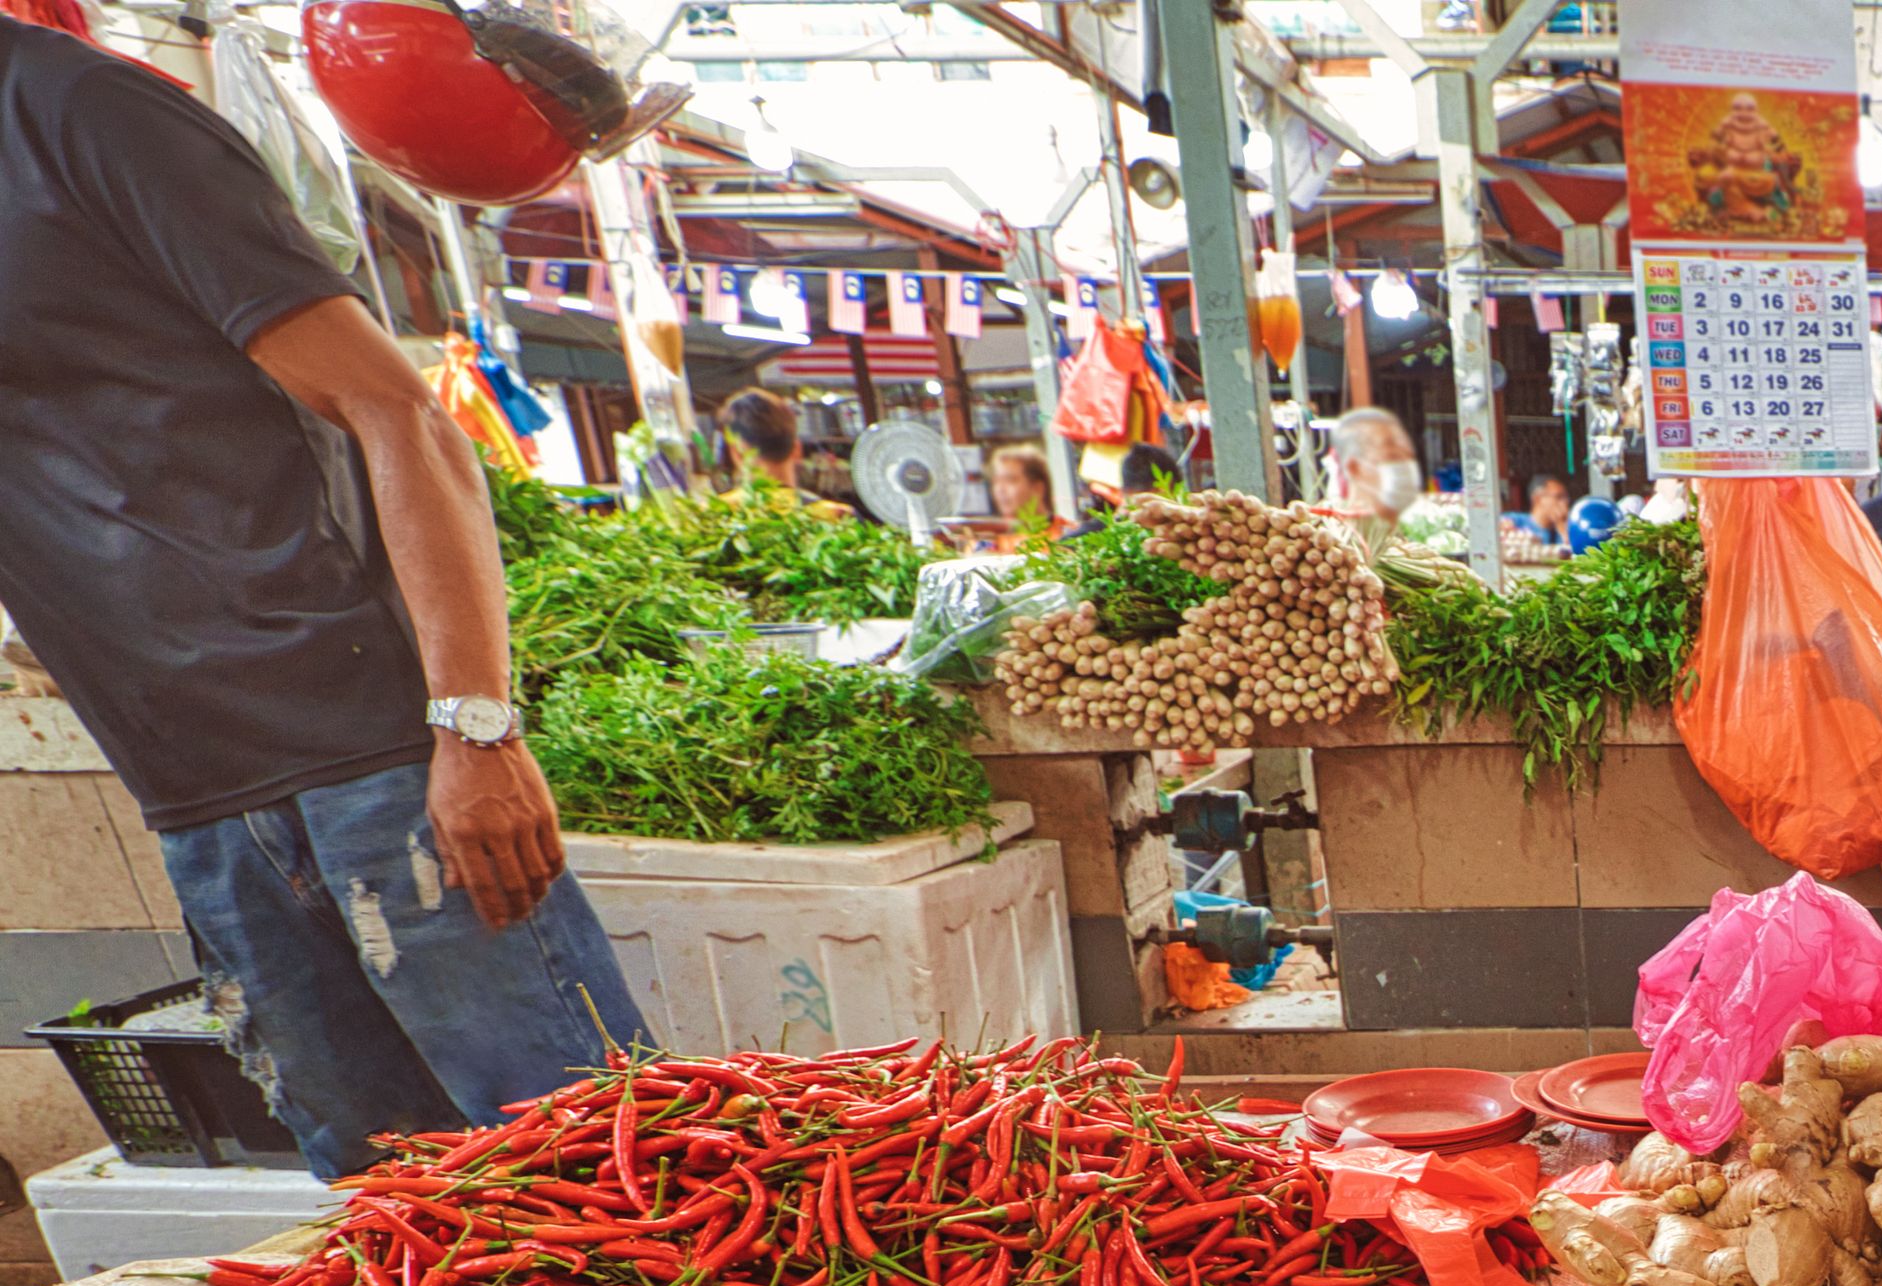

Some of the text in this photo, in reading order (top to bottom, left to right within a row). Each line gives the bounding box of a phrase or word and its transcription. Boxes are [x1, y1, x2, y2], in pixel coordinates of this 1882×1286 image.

[1649, 266, 1675, 279] SUN
[1650, 294, 1678, 305] MON
[1694, 291, 1707, 309] 2
[1729, 292, 1743, 309] 9
[1760, 292, 1785, 310] 16
[1831, 294, 1855, 311] 30
[1654, 319, 1854, 338] TUE 3 10 17 24 31
[1653, 346, 1823, 365] WED 4 11 18 25
[1657, 373, 1824, 391] THU 5 12 19 26
[1662, 400, 1825, 417] FRI 6 13 20 27
[1662, 429, 1685, 440] SAT
